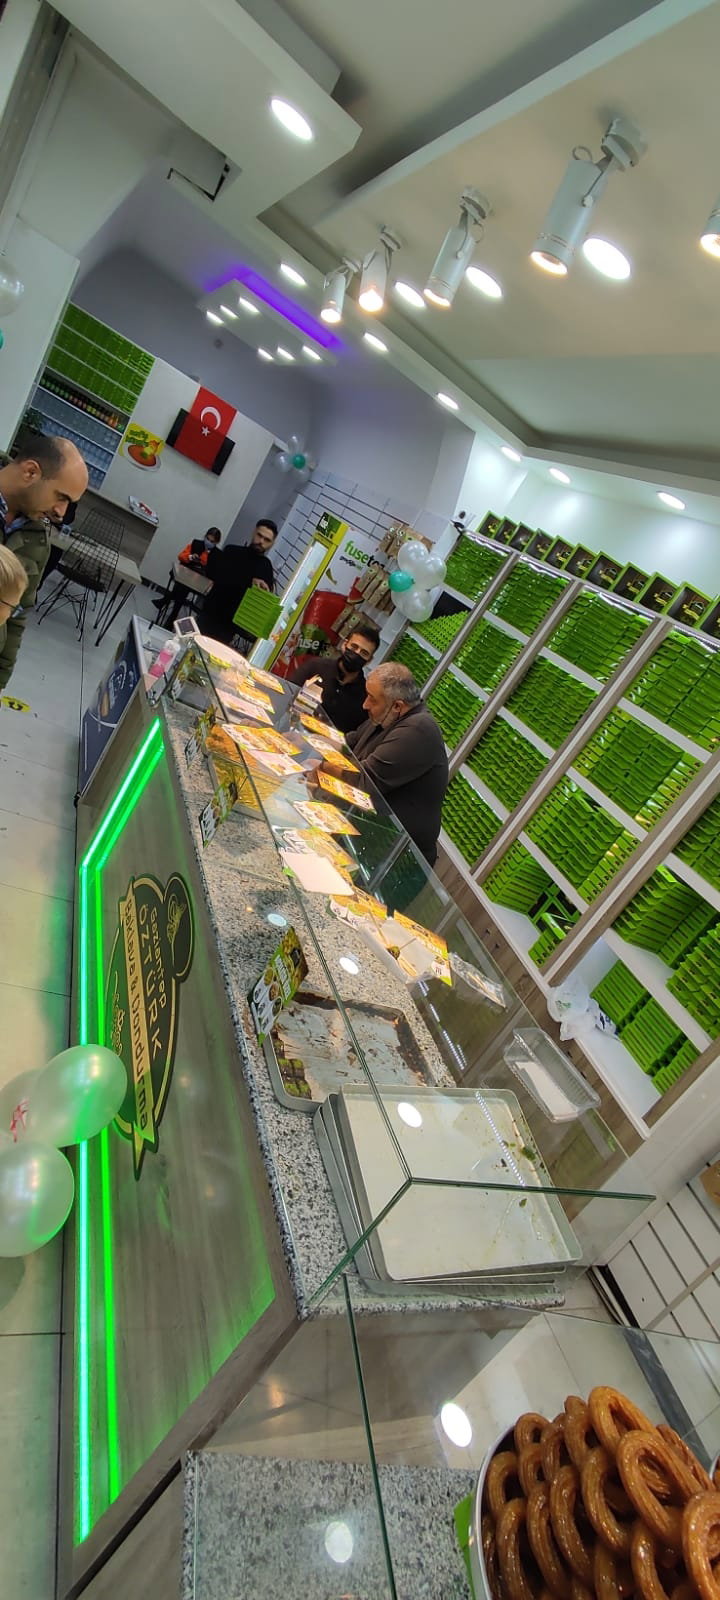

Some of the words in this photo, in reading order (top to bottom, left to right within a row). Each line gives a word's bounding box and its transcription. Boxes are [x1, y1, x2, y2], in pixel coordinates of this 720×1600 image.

[125, 899, 136, 977] Baklava
[131, 995, 148, 1131] Dondurma
[139, 903, 163, 1062] ÖZTÜRK
[150, 905, 167, 1009] Gaziantep
